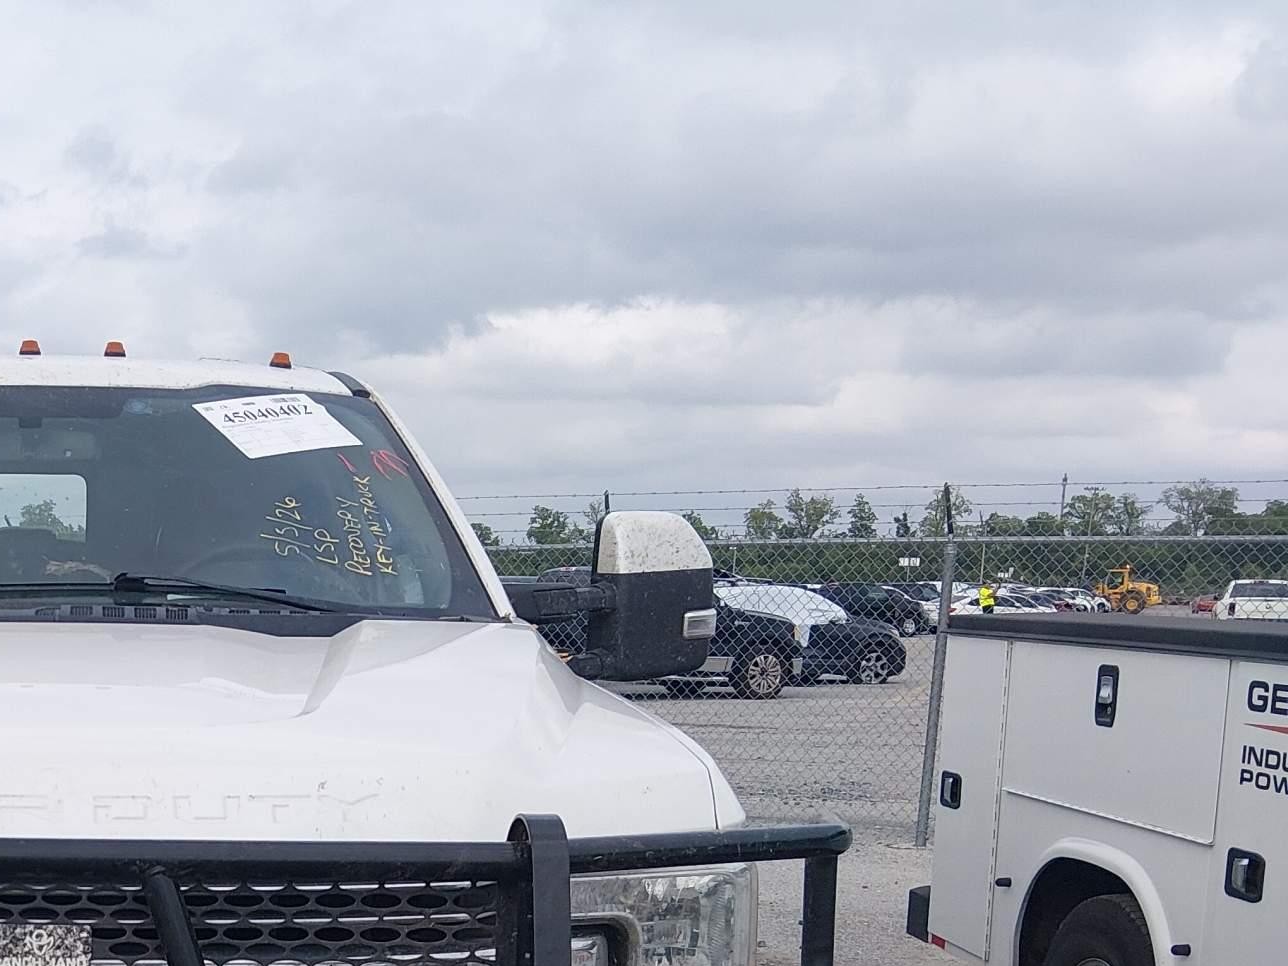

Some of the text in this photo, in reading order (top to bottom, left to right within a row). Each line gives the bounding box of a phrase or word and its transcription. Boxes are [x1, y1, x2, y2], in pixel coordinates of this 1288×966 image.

[222, 404, 313, 424] 45040402
[313, 528, 340, 565] LSP
[90, 791, 382, 827] DUTY
